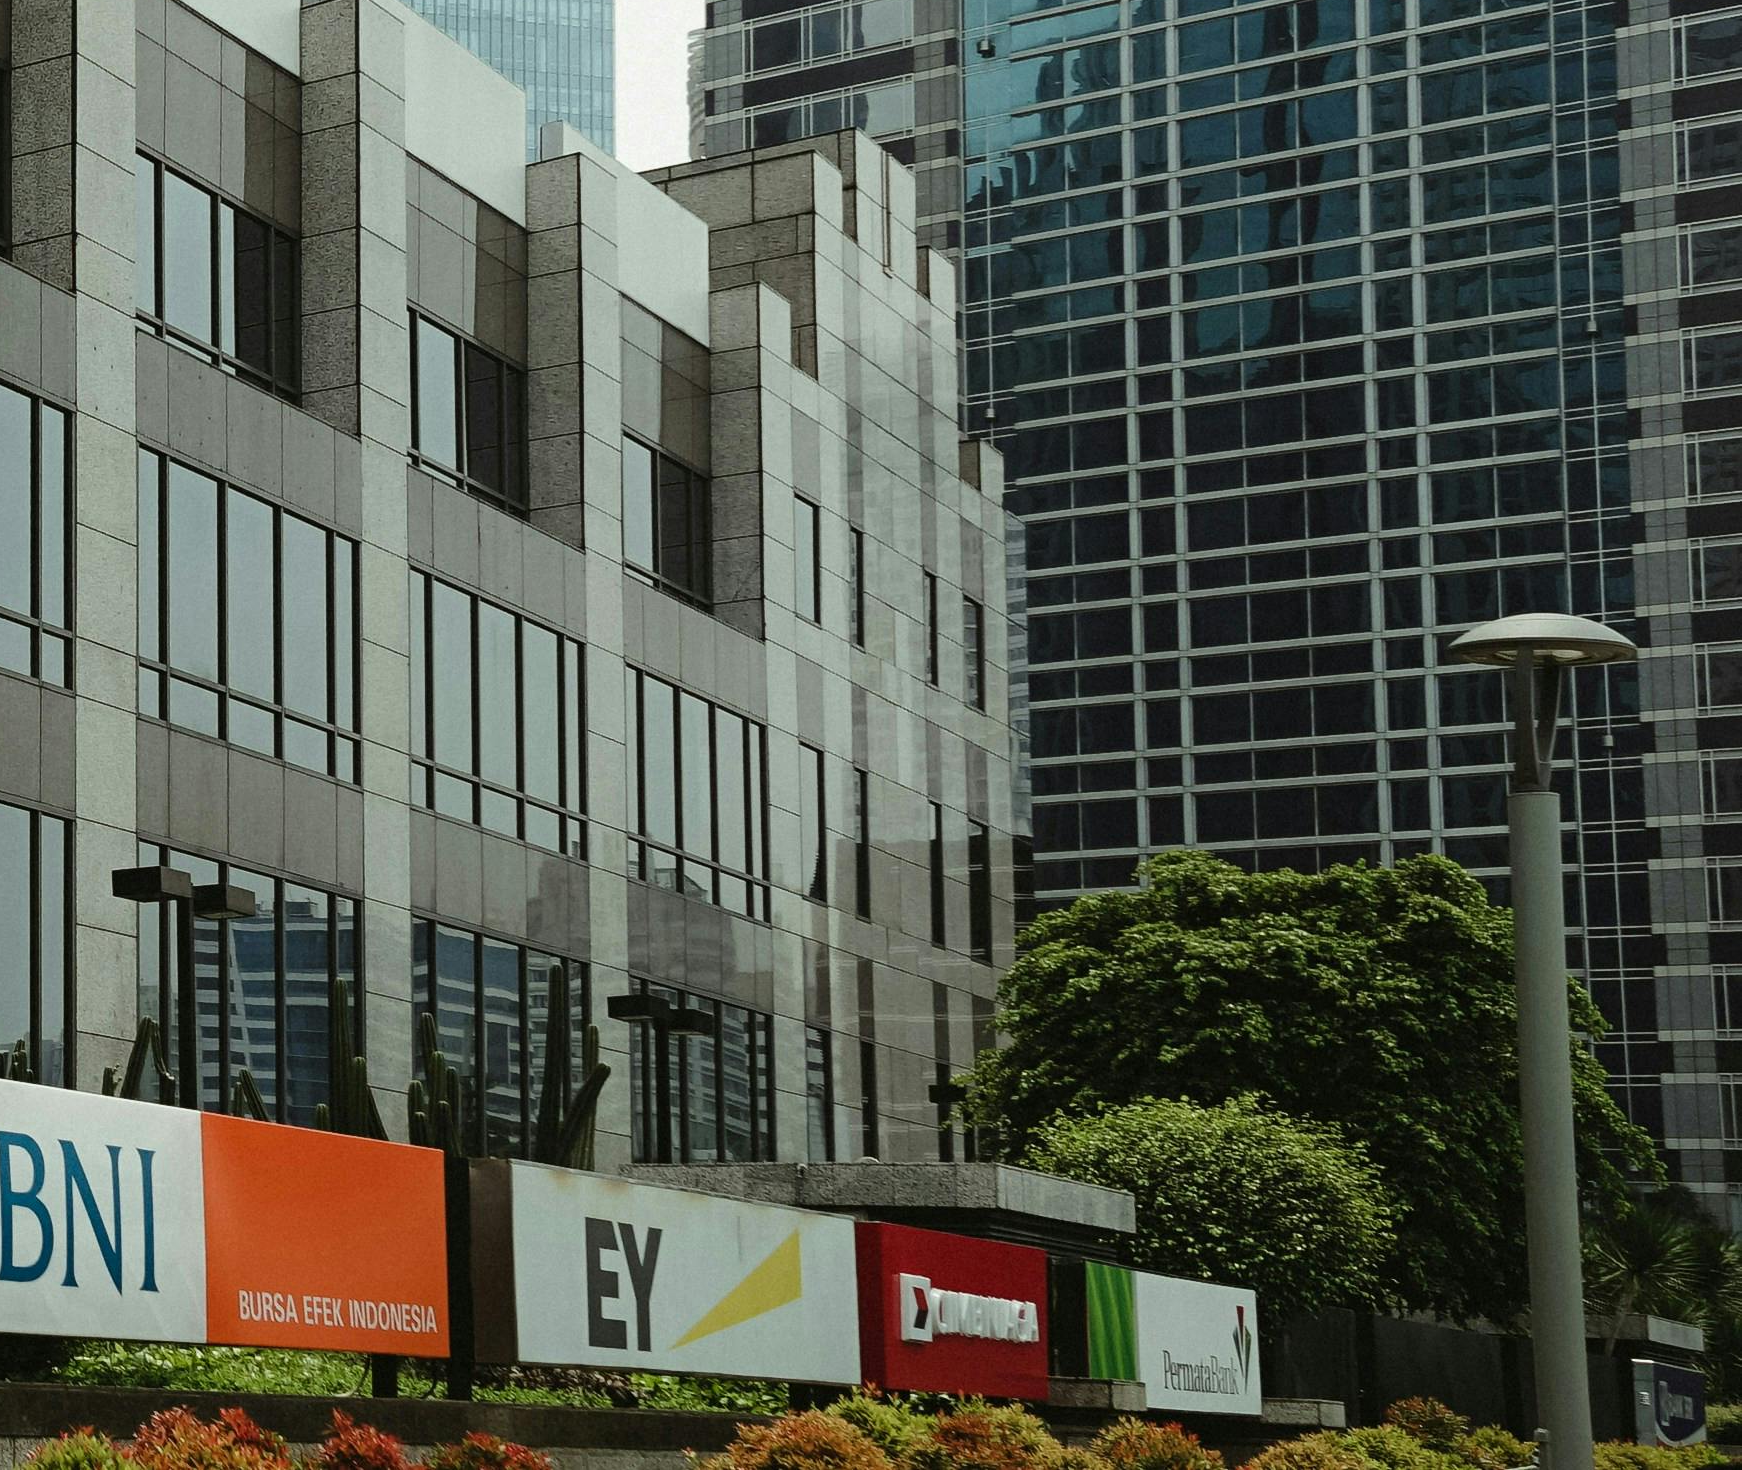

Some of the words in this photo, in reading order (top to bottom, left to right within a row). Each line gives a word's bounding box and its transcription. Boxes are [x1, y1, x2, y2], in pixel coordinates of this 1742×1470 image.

[584, 1216, 663, 1353] EY
[238, 1289, 299, 1324] BURSA
[303, 1294, 345, 1327] EFEK
[348, 1298, 438, 1333] INDONESIA
[1162, 1349, 1240, 1395] PermataBank
